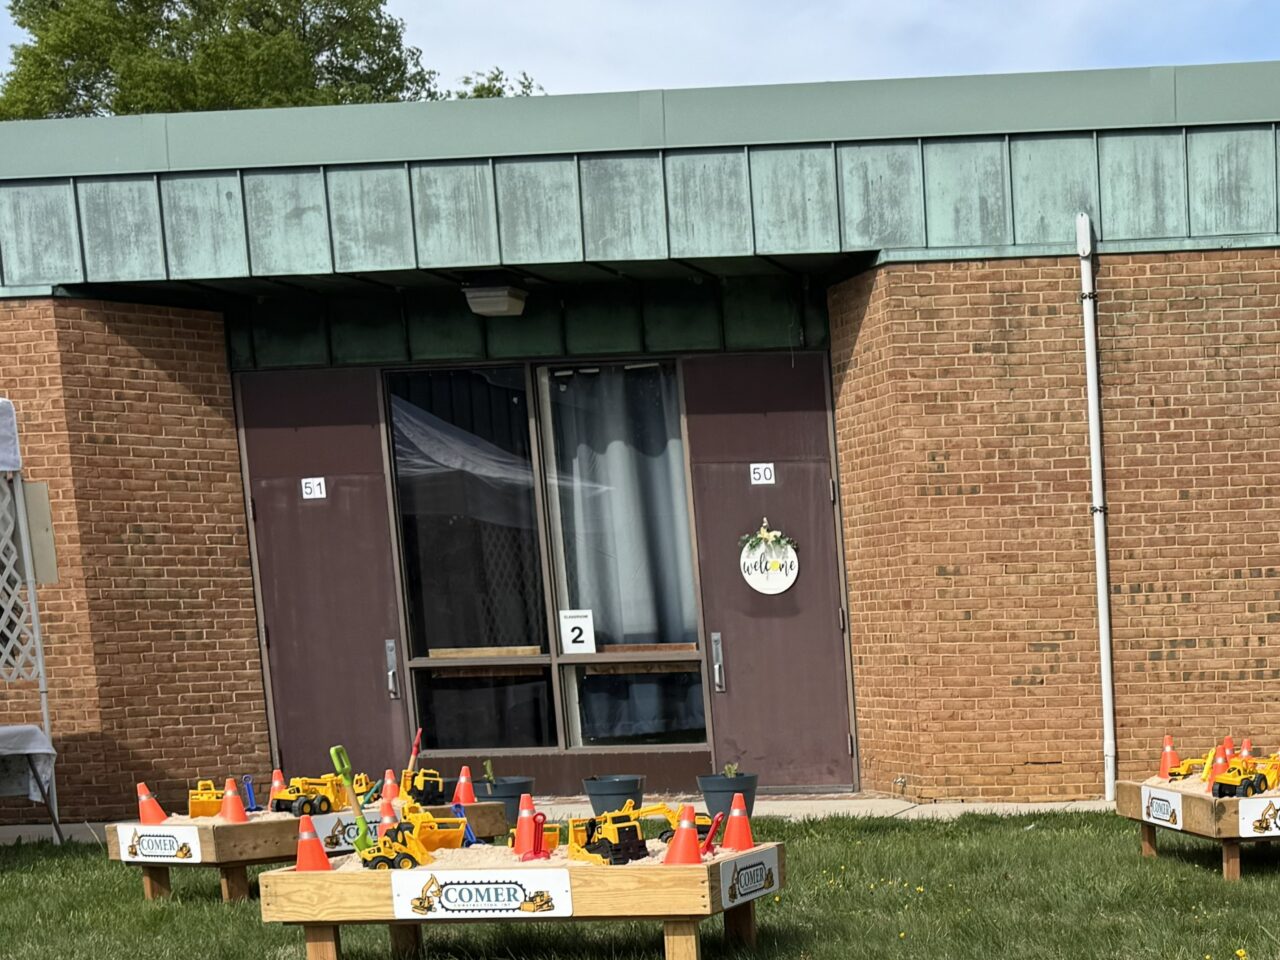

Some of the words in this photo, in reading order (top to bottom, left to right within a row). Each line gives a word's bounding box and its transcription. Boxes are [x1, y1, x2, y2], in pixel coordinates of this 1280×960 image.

[752, 467, 772, 481] 50
[304, 481, 323, 496] 51
[570, 626, 585, 644] 2
[141, 838, 176, 851] COMER
[739, 867, 765, 889] COMER
[444, 887, 520, 904] COMER
